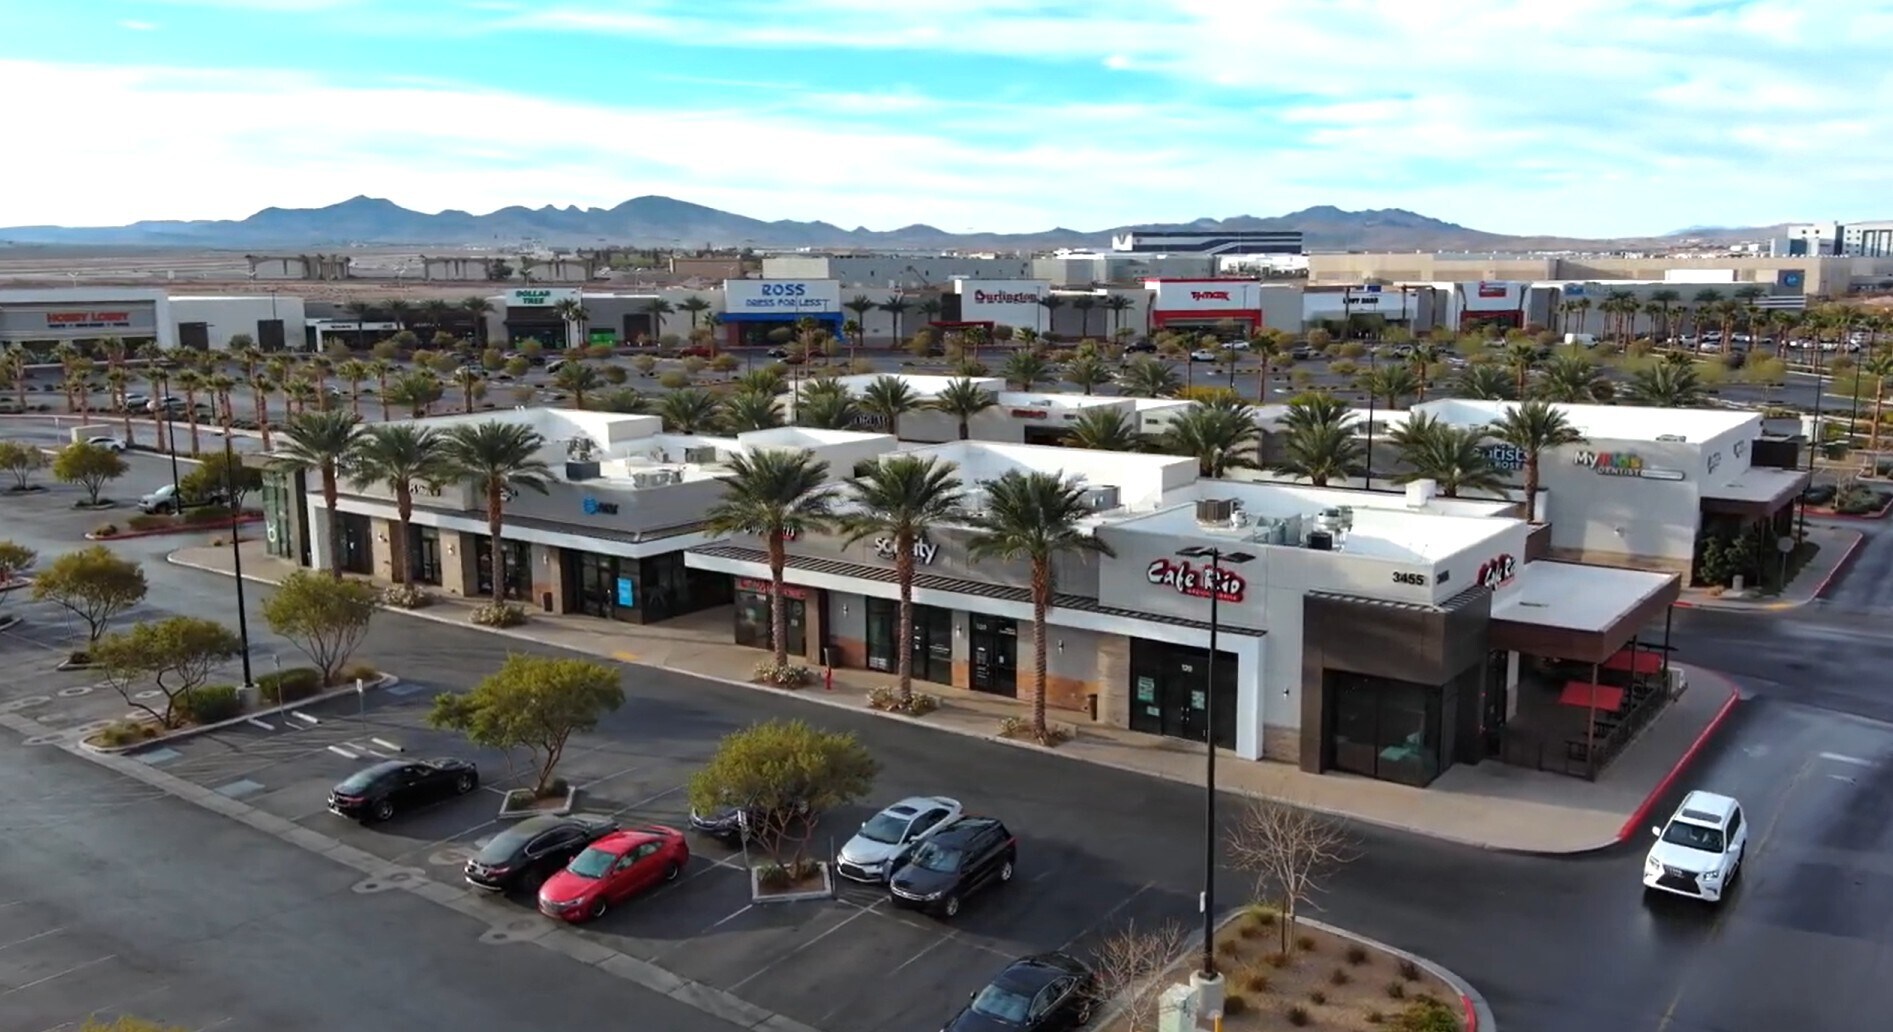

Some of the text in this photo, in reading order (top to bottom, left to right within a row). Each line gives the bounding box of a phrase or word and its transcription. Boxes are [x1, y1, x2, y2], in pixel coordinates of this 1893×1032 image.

[515, 290, 551, 298] DOLLAR
[761, 283, 806, 296] ROSS
[974, 289, 1038, 304] Burlington
[745, 299, 775, 307] DRESS
[46, 311, 129, 323] HOBBY LOBBY
[1597, 466, 1641, 478] DENTIST
[1147, 561, 1241, 594] Cafe Rio
[1392, 571, 1425, 587] 3455
